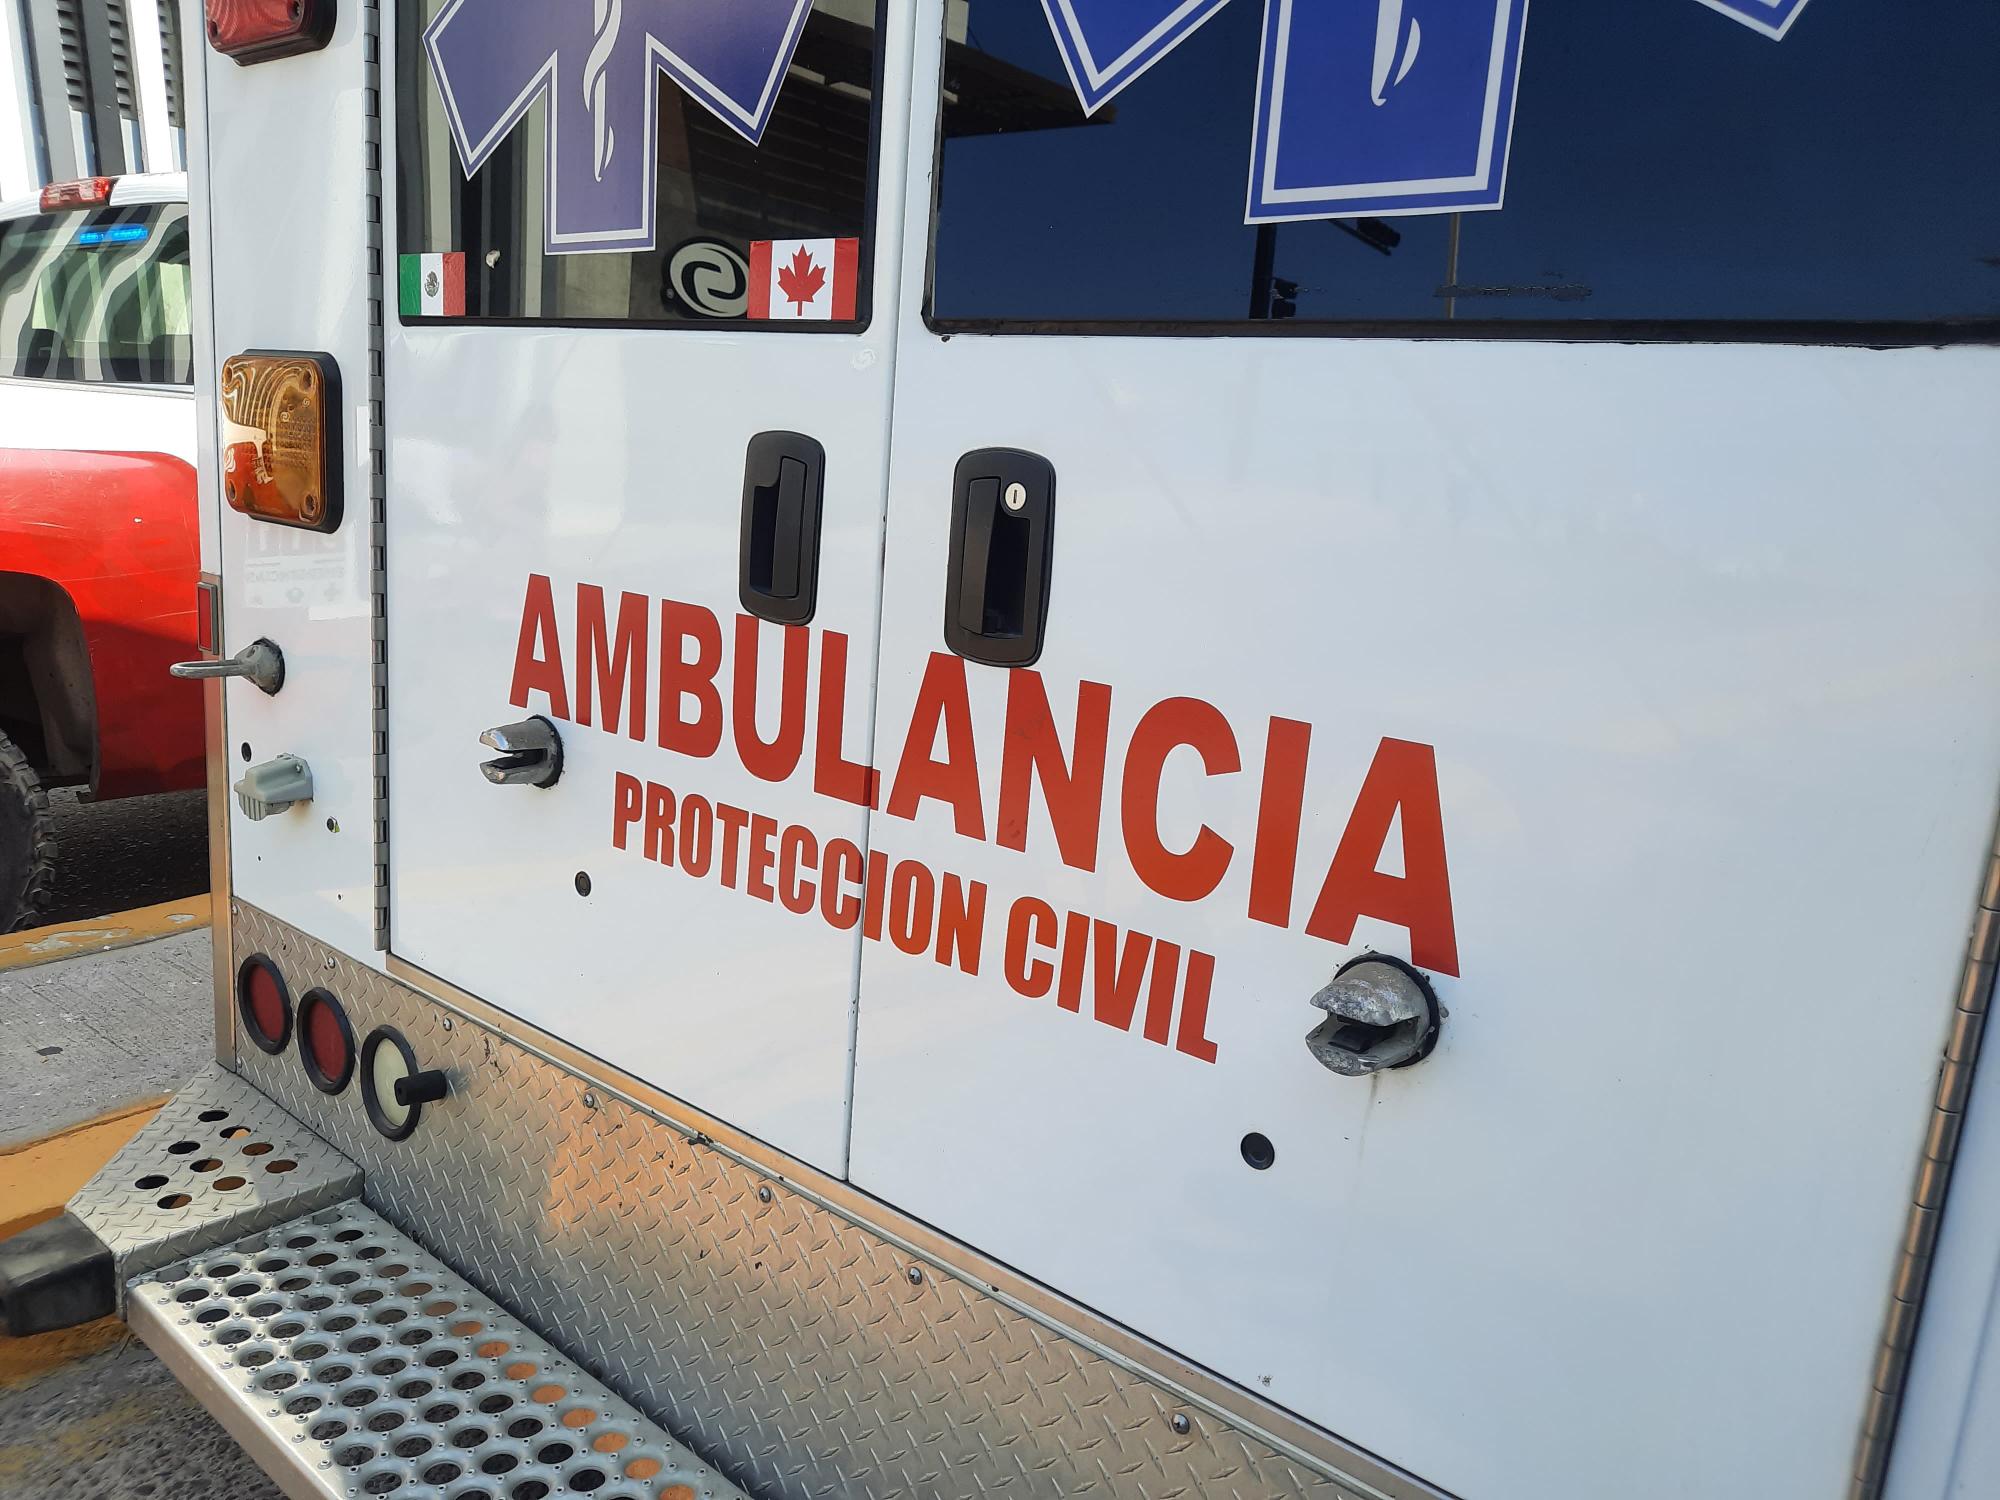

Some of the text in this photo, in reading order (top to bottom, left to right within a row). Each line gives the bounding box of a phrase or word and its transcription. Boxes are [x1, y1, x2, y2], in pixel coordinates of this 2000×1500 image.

[509, 574, 1459, 977] AMBULANCIA
[613, 771, 1218, 1063] PROTECCION CIVIL
